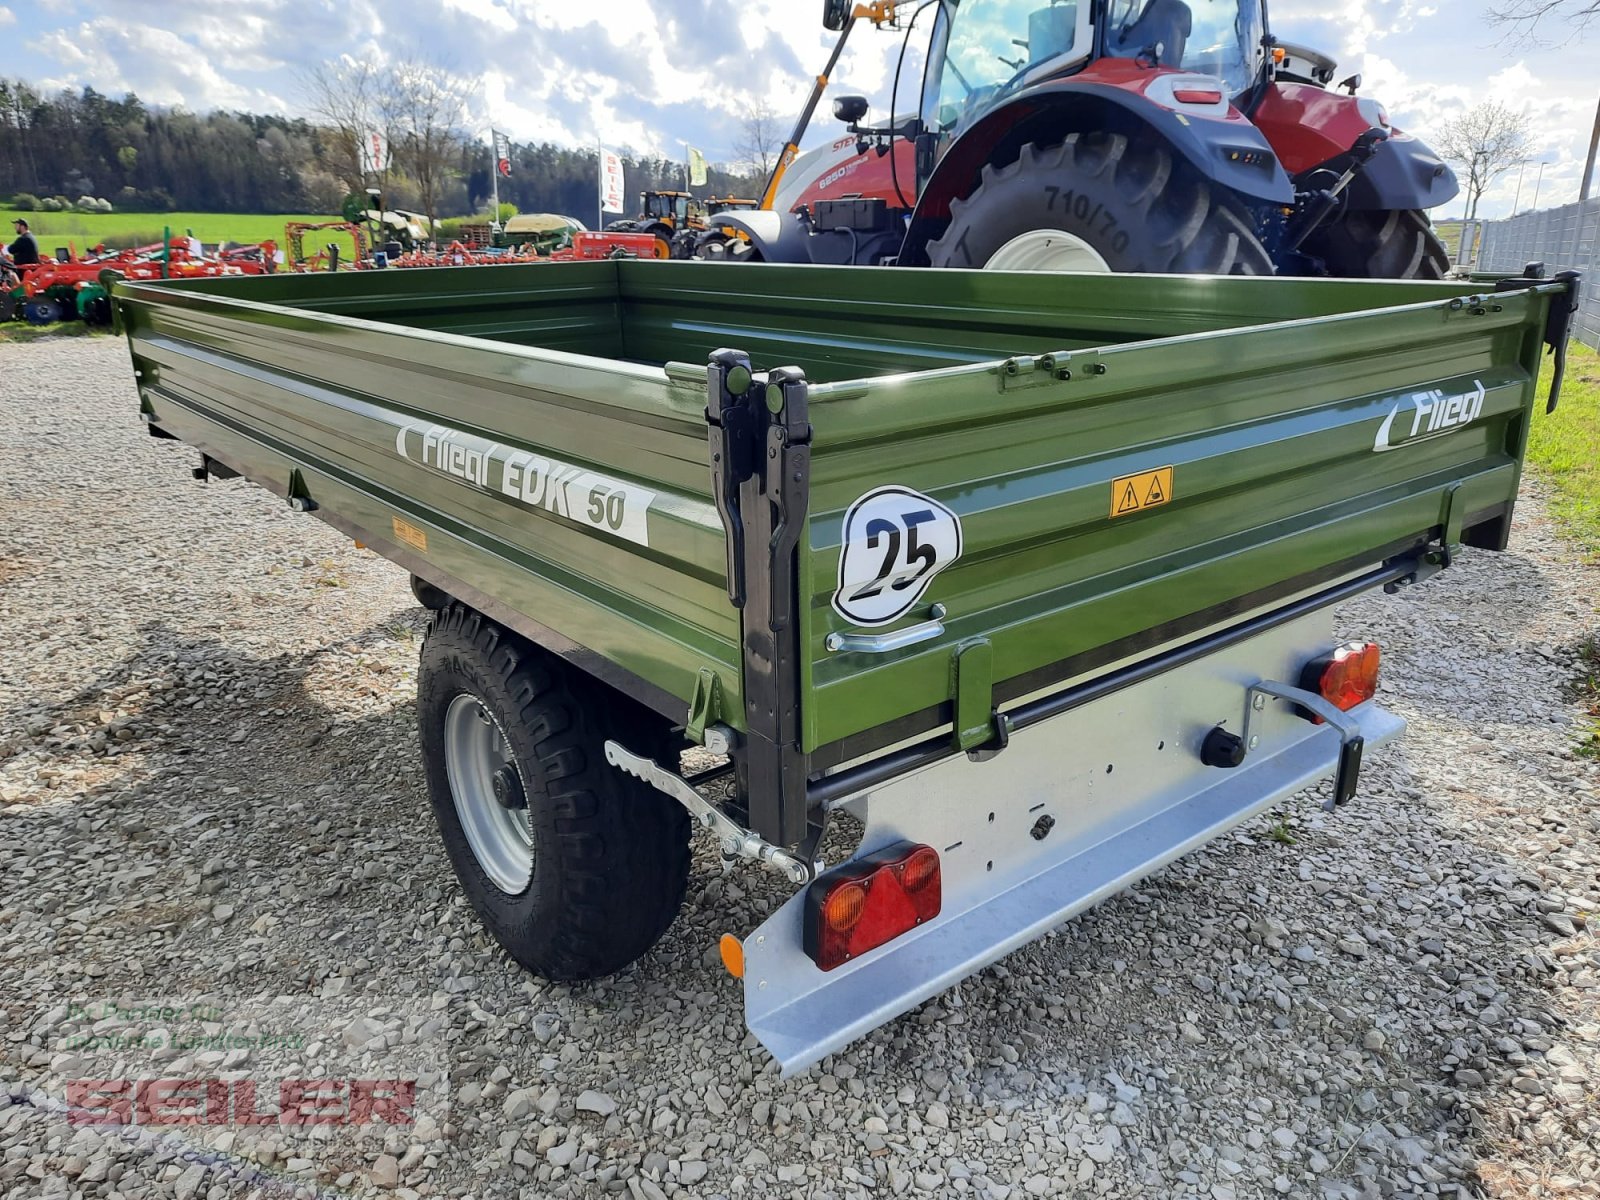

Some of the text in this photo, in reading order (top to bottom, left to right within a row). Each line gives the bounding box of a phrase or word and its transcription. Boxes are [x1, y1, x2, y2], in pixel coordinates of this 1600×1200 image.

[832, 135, 859, 152] STEY
[819, 167, 846, 189] 6250
[1045, 186, 1130, 254] 710/70
[1410, 379, 1486, 437] Fliegl
[422, 424, 627, 530] Fliegl EDK 50
[848, 509, 937, 602] 25
